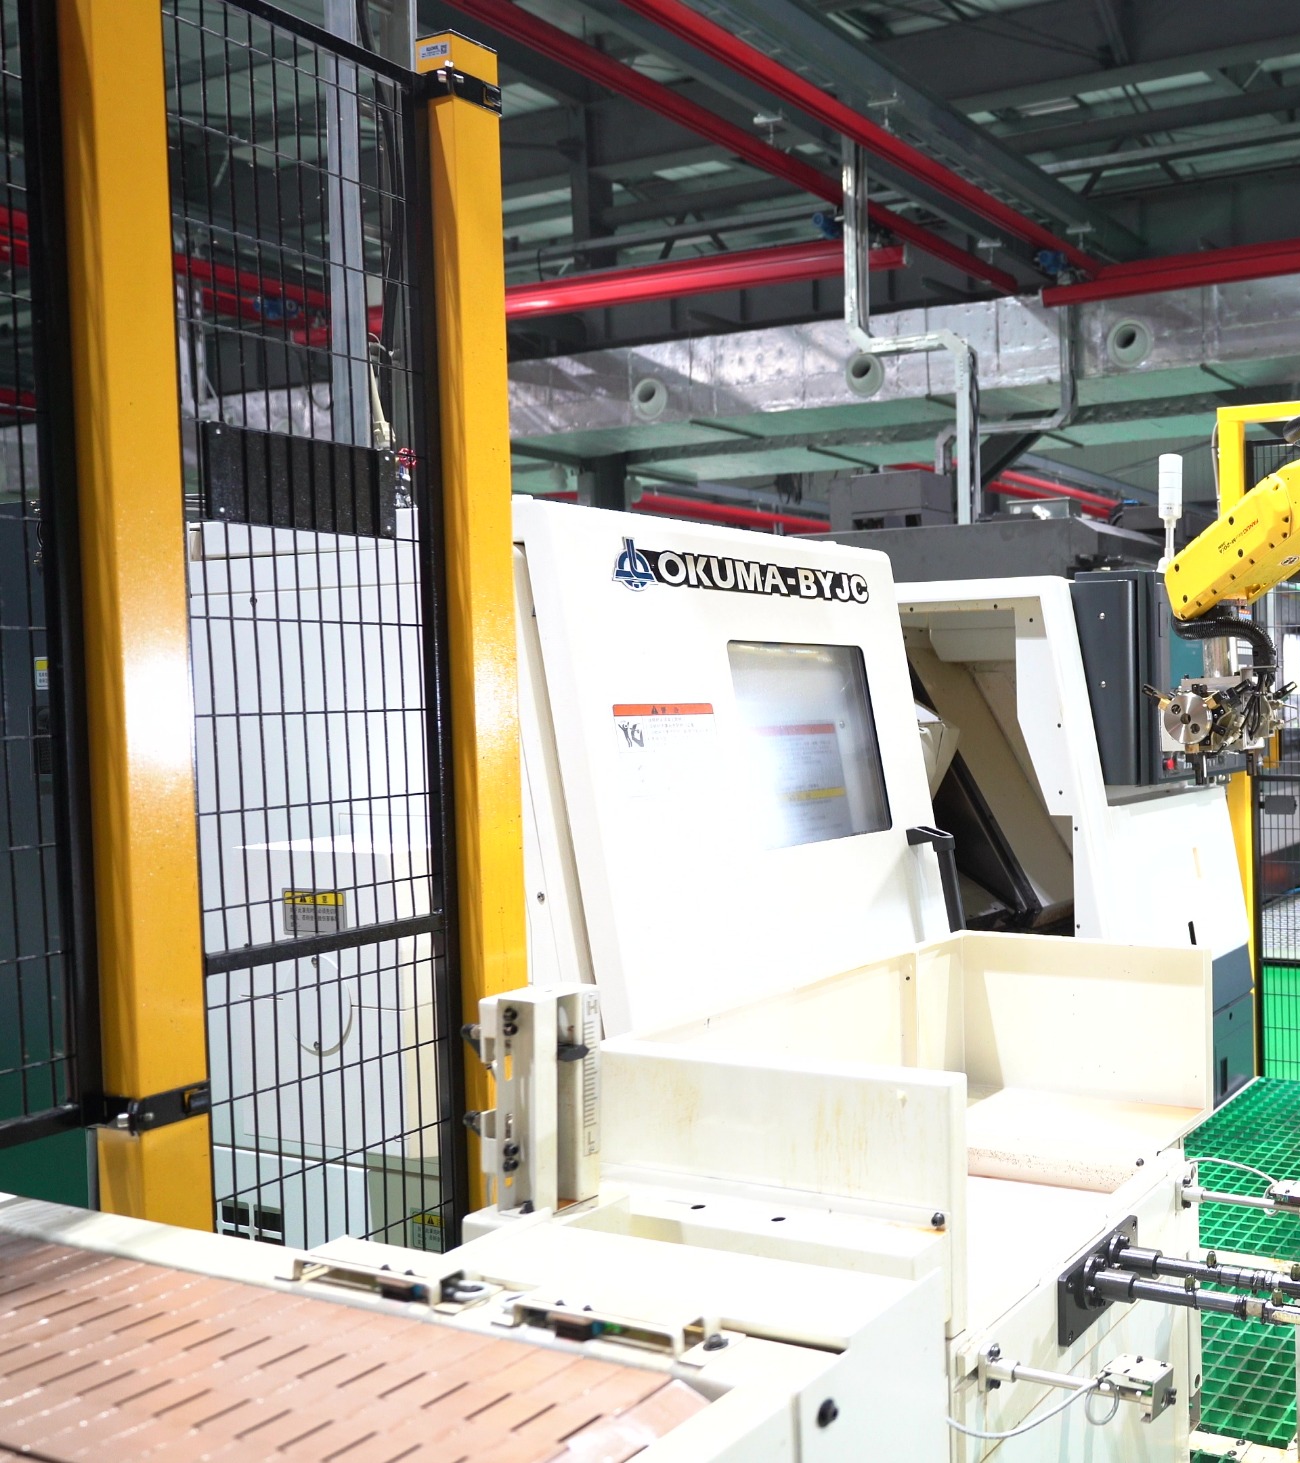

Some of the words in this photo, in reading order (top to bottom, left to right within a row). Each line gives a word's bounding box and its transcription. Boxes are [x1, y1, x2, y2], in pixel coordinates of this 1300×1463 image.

[657, 550, 870, 604] OKUMA-BYJC
[586, 1000, 598, 1016] H
[586, 1131, 595, 1146] L
